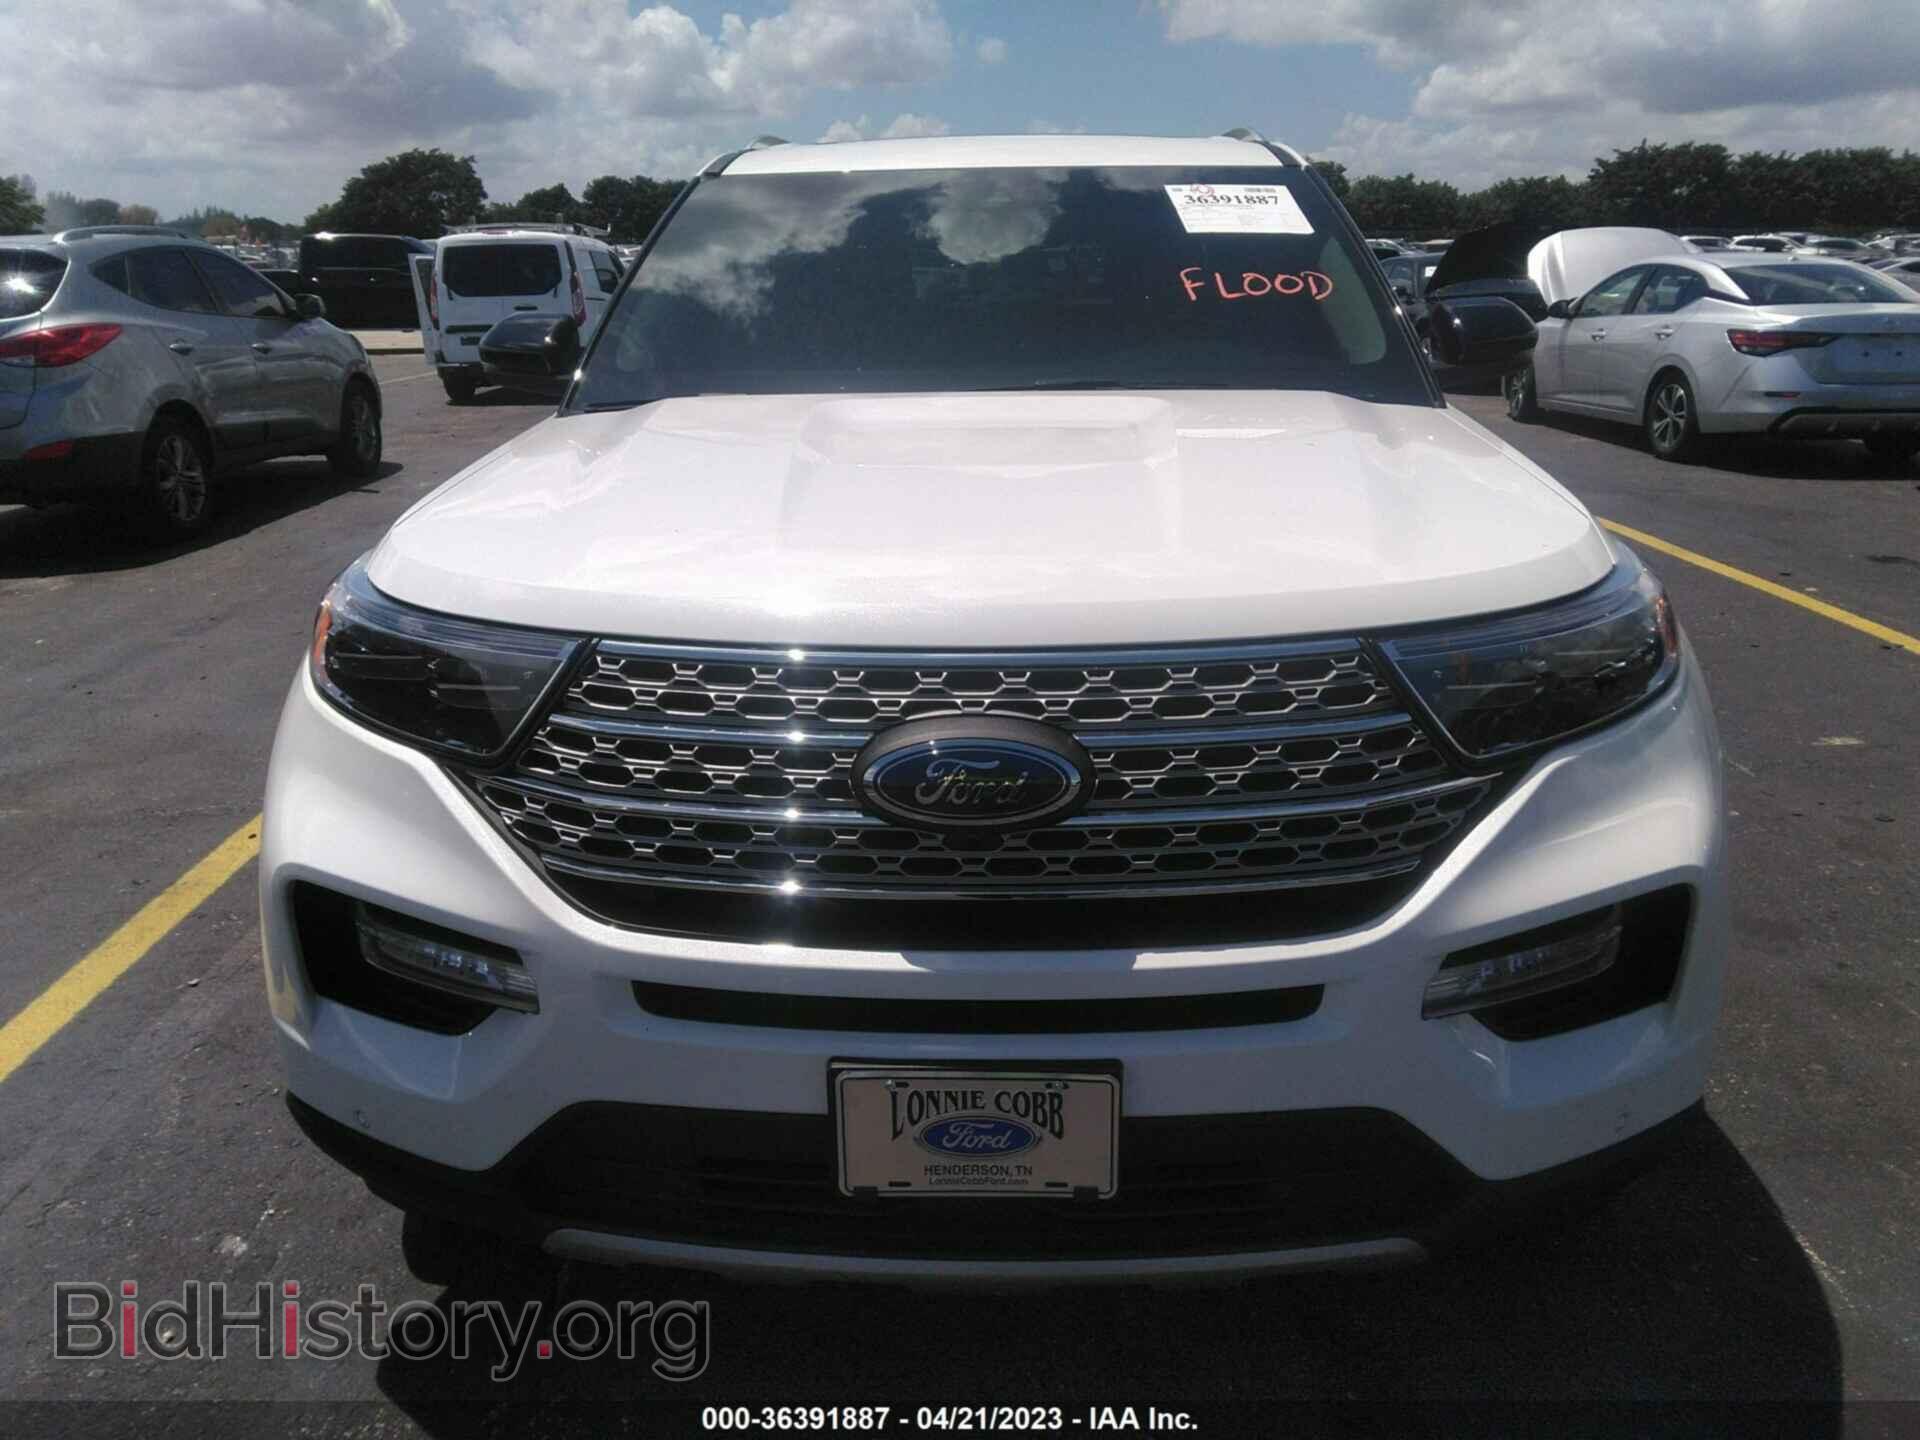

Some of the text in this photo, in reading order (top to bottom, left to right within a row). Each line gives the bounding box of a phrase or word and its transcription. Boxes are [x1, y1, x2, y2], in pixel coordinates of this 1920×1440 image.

[1184, 194, 1279, 206] 36391887
[1180, 267, 1333, 301] FLOOD
[915, 758, 1027, 805] Ford
[889, 1090, 1065, 1141] LONNIE COBB
[942, 1122, 1012, 1149] Ford
[924, 1165, 1033, 1177] HENDERSON, TN
